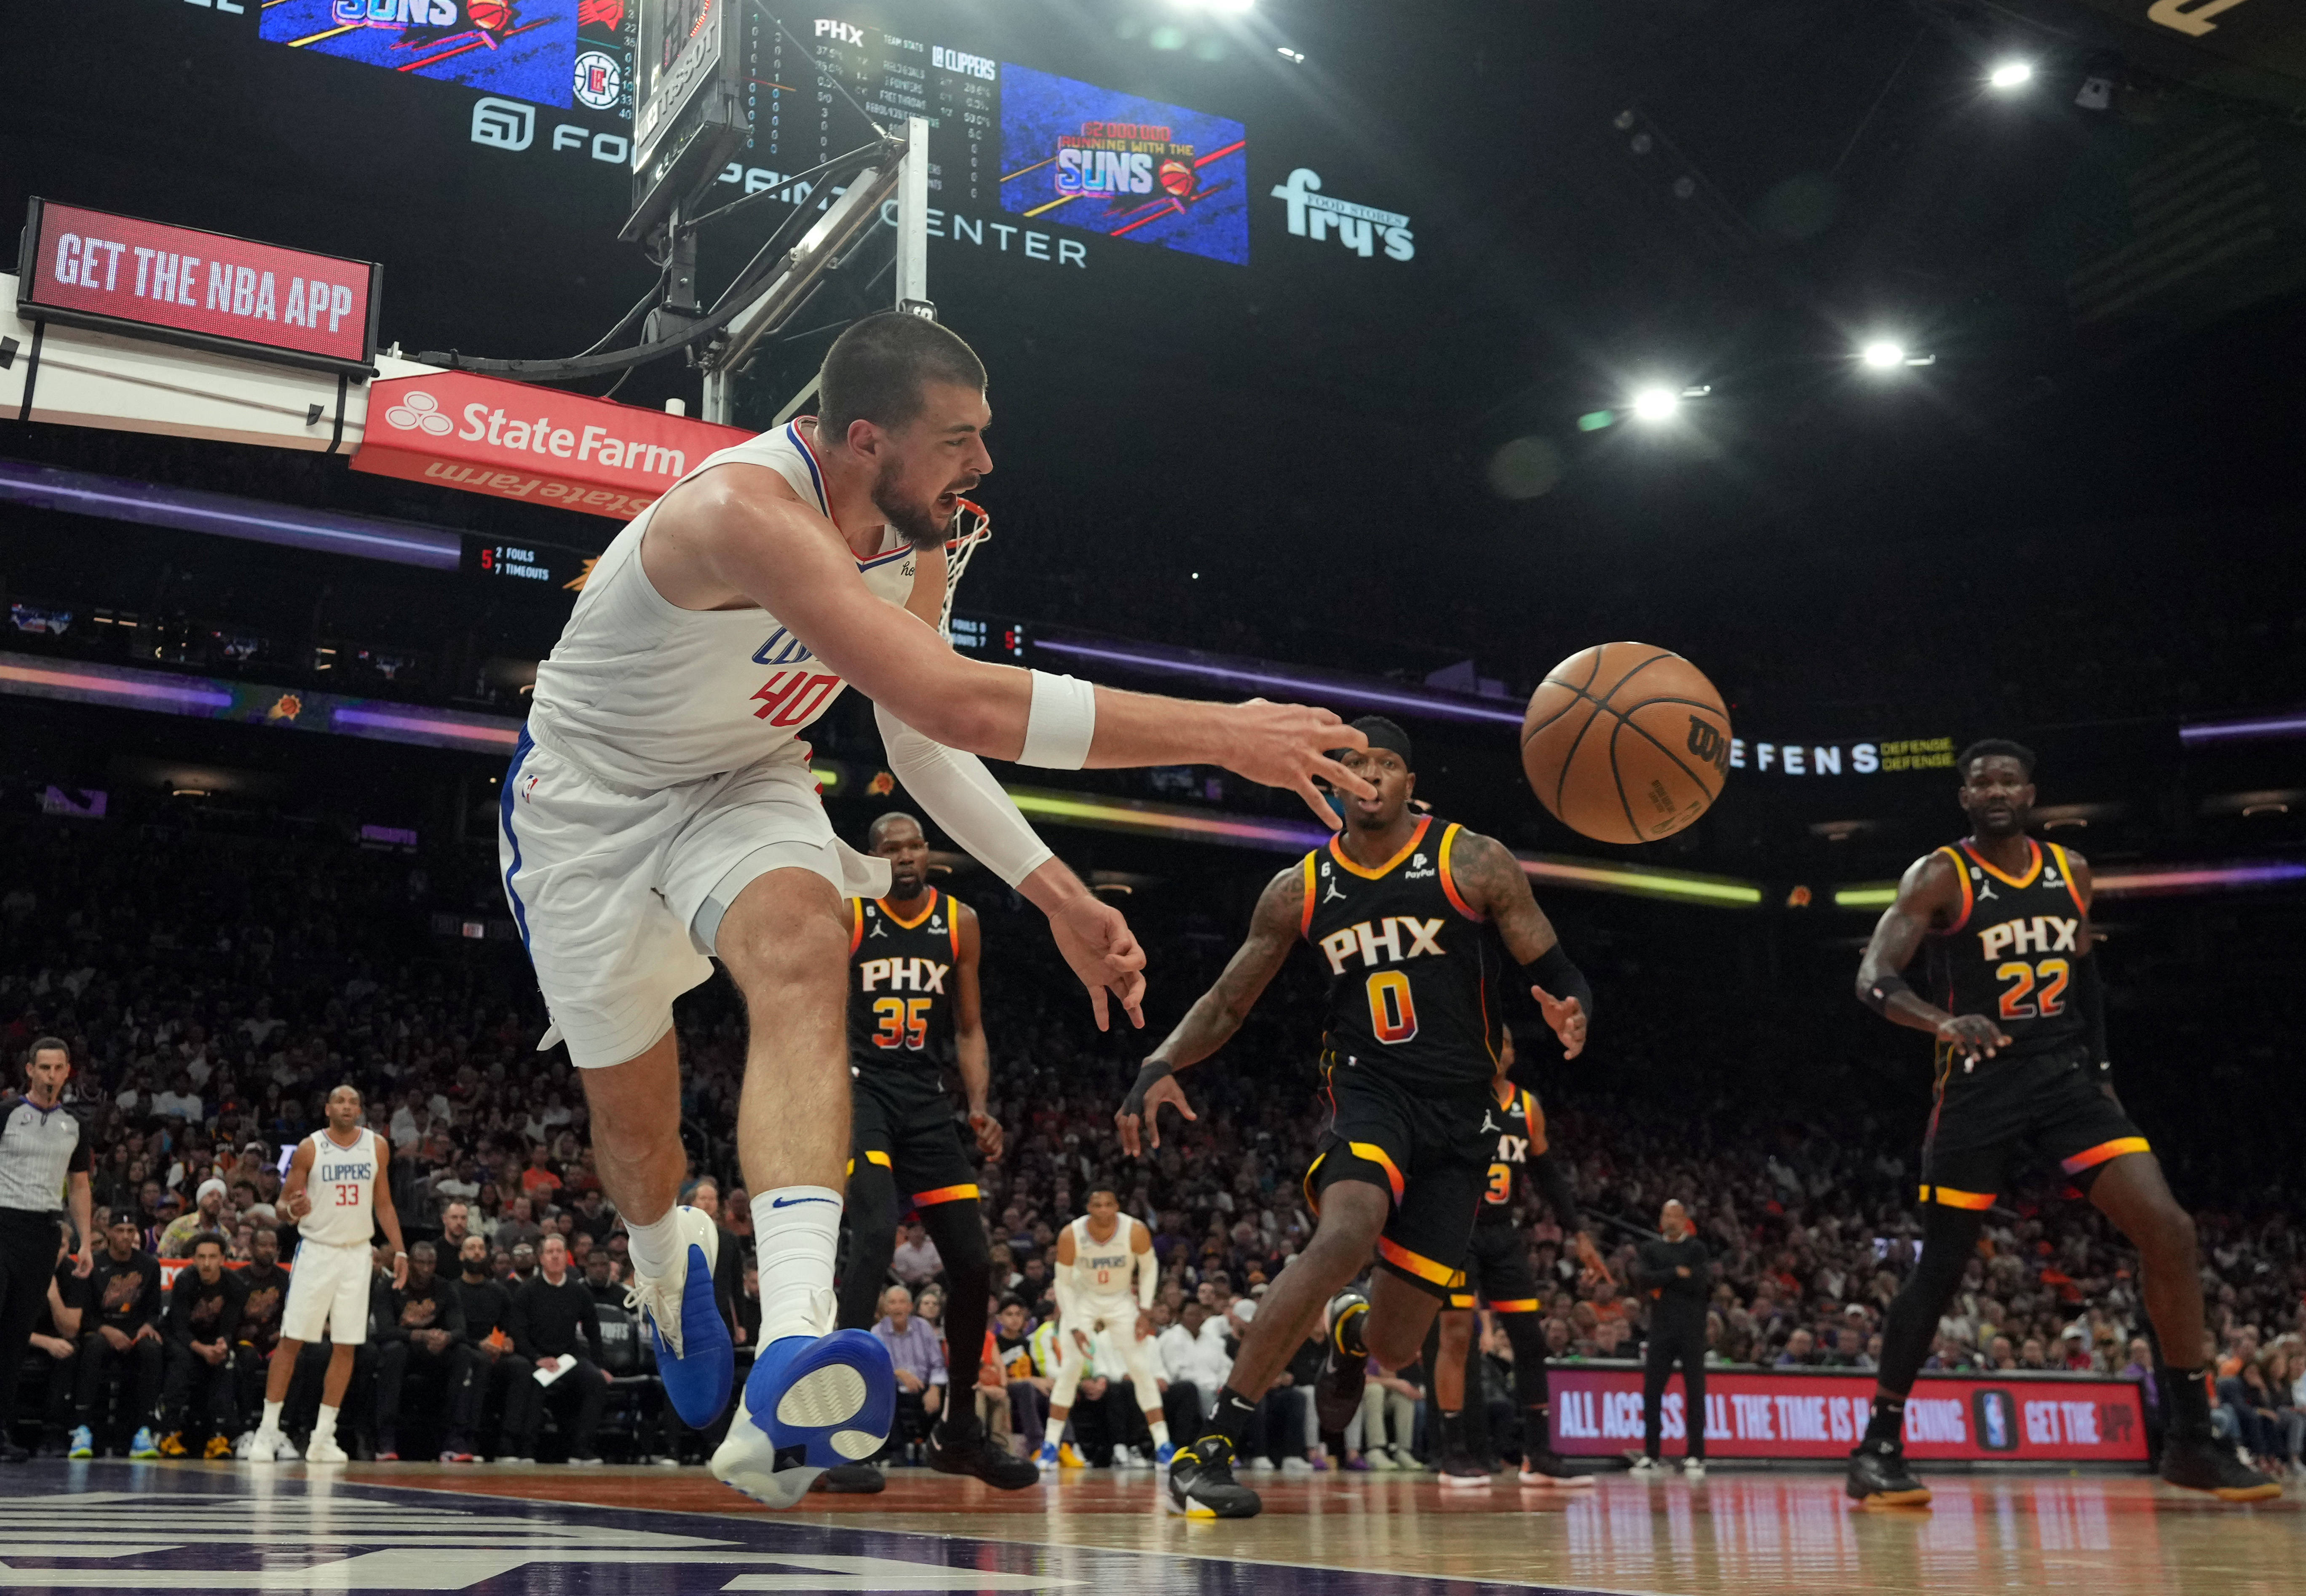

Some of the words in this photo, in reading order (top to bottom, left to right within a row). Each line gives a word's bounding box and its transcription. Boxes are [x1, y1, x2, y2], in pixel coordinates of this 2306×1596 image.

[815, 19, 864, 48] PHX
[658, 19, 716, 115] TISSOT
[945, 48, 995, 81] CLIPPERS
[1061, 136, 1126, 152] RUNNING
[1132, 141, 1165, 154] WITH
[1169, 144, 1194, 156] THE
[1058, 148, 1153, 194] SUNS
[1271, 168, 1415, 262] fry's
[55, 233, 126, 291] GET
[134, 246, 201, 306] THE
[206, 261, 277, 321] NBA
[284, 277, 353, 333] APP
[482, 549, 492, 569] 5
[495, 546, 503, 559] 2
[506, 547, 535, 563] FOULS
[495, 563, 502, 575] 7
[506, 563, 549, 581] TIMEOUTS
[1005, 631, 1015, 650] 5
[749, 671, 841, 727] 40
[1730, 738, 1879, 775] EFENS
[1321, 862, 1331, 877] 6
[1405, 868, 1435, 880] PayPal
[1319, 916, 1447, 976] PHX
[1977, 916, 2079, 961] PHX
[859, 957, 950, 995] PHX
[1996, 958, 2069, 1020] 22
[872, 997, 932, 1051] 35
[1366, 970, 1418, 1045] 0
[322, 1163, 371, 1182] CLIPPERS
[1485, 1163, 1511, 1205] 3
[335, 1184, 358, 1206] 33
[1097, 1270, 1109, 1284] 0
[1560, 1390, 1599, 1439] ALL
[1602, 1391, 1686, 1439] ACCSS
[1704, 1393, 1732, 1440] LL
[1731, 1394, 1774, 1441] THE
[1774, 1395, 1828, 1441] TIME
[1828, 1396, 1852, 1442] IS
[2025, 1401, 2060, 1444] GET
[2060, 1401, 2100, 1445] THE
